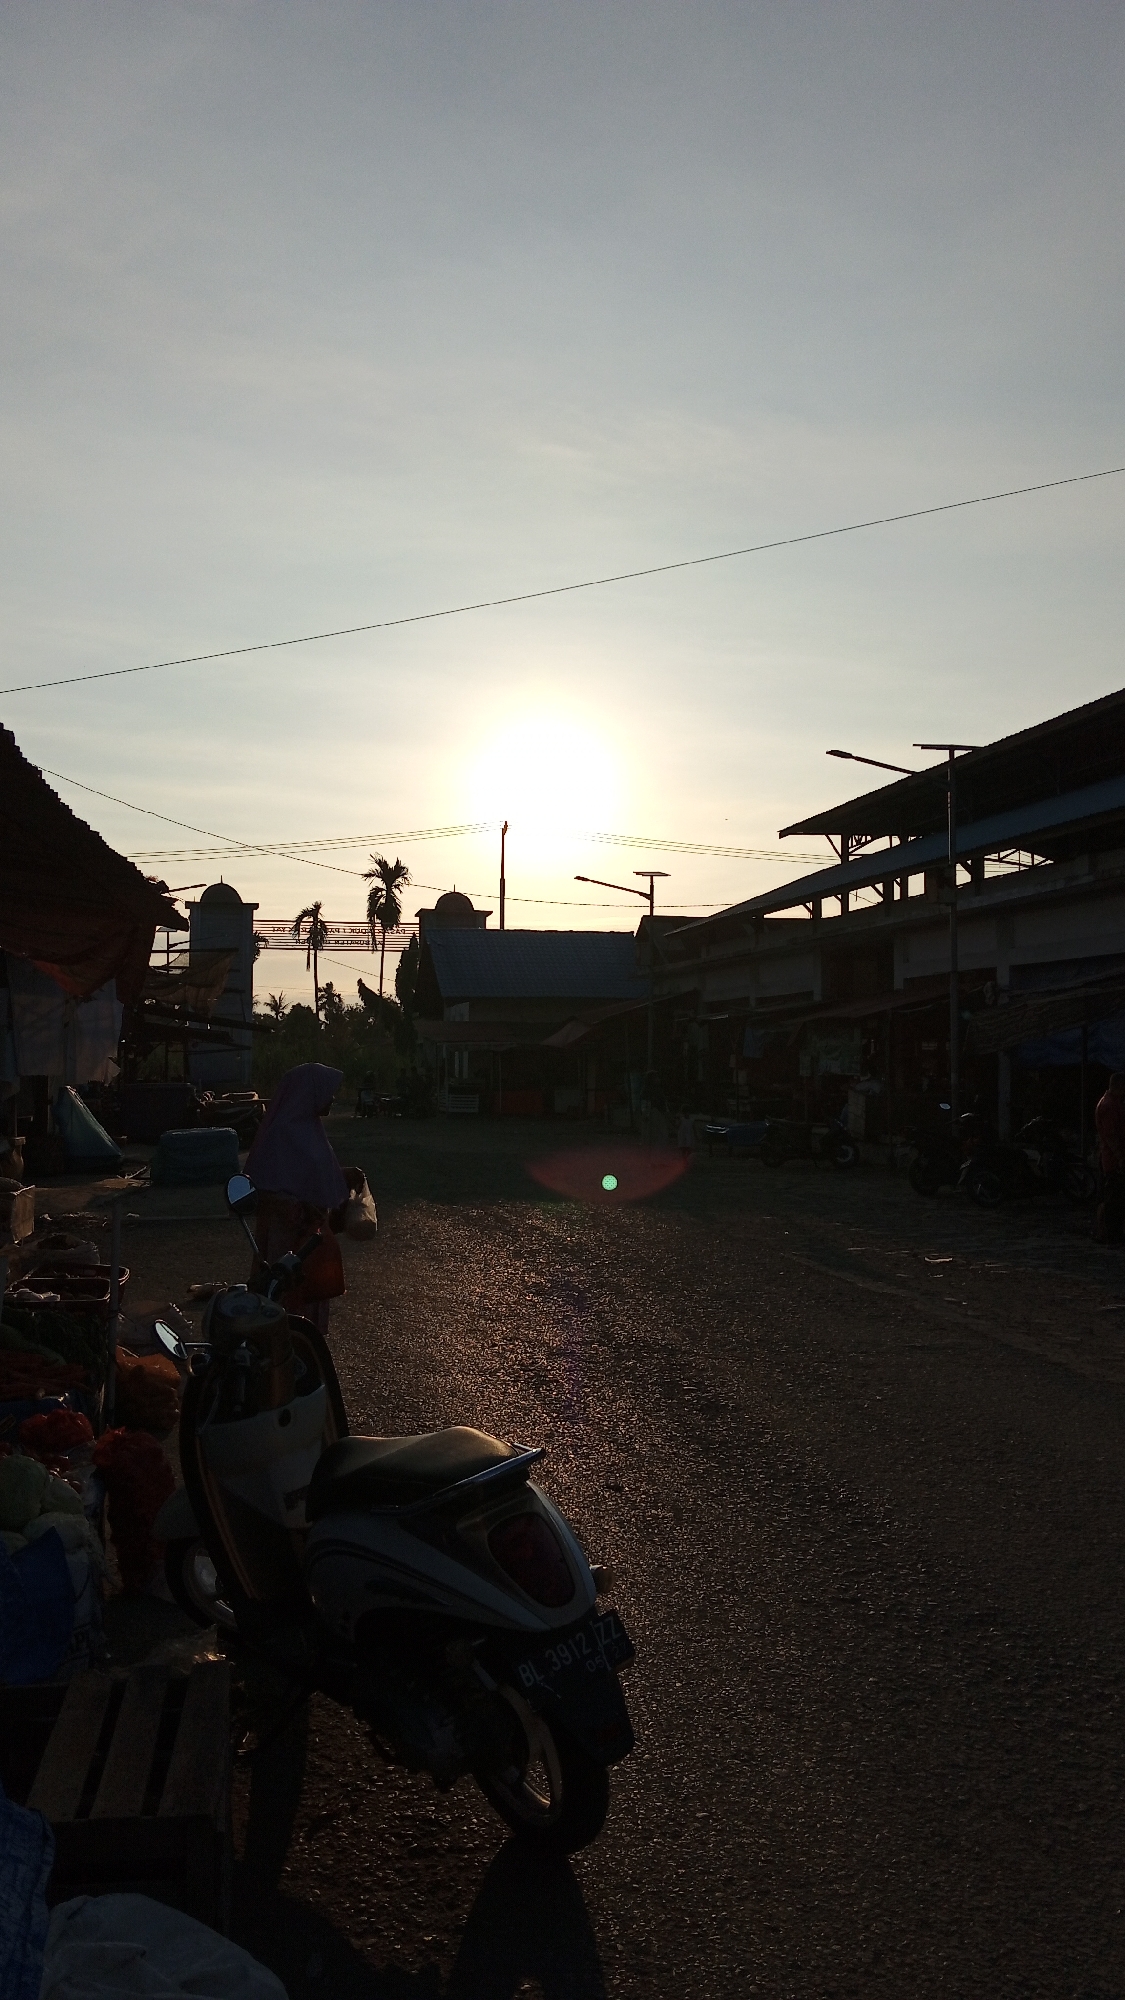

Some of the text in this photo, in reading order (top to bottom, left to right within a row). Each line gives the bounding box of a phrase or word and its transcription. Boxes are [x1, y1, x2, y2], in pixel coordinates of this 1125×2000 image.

[518, 1660, 544, 1688] BL
[545, 1632, 593, 1672] 3912
[586, 1655, 604, 1673] 05
